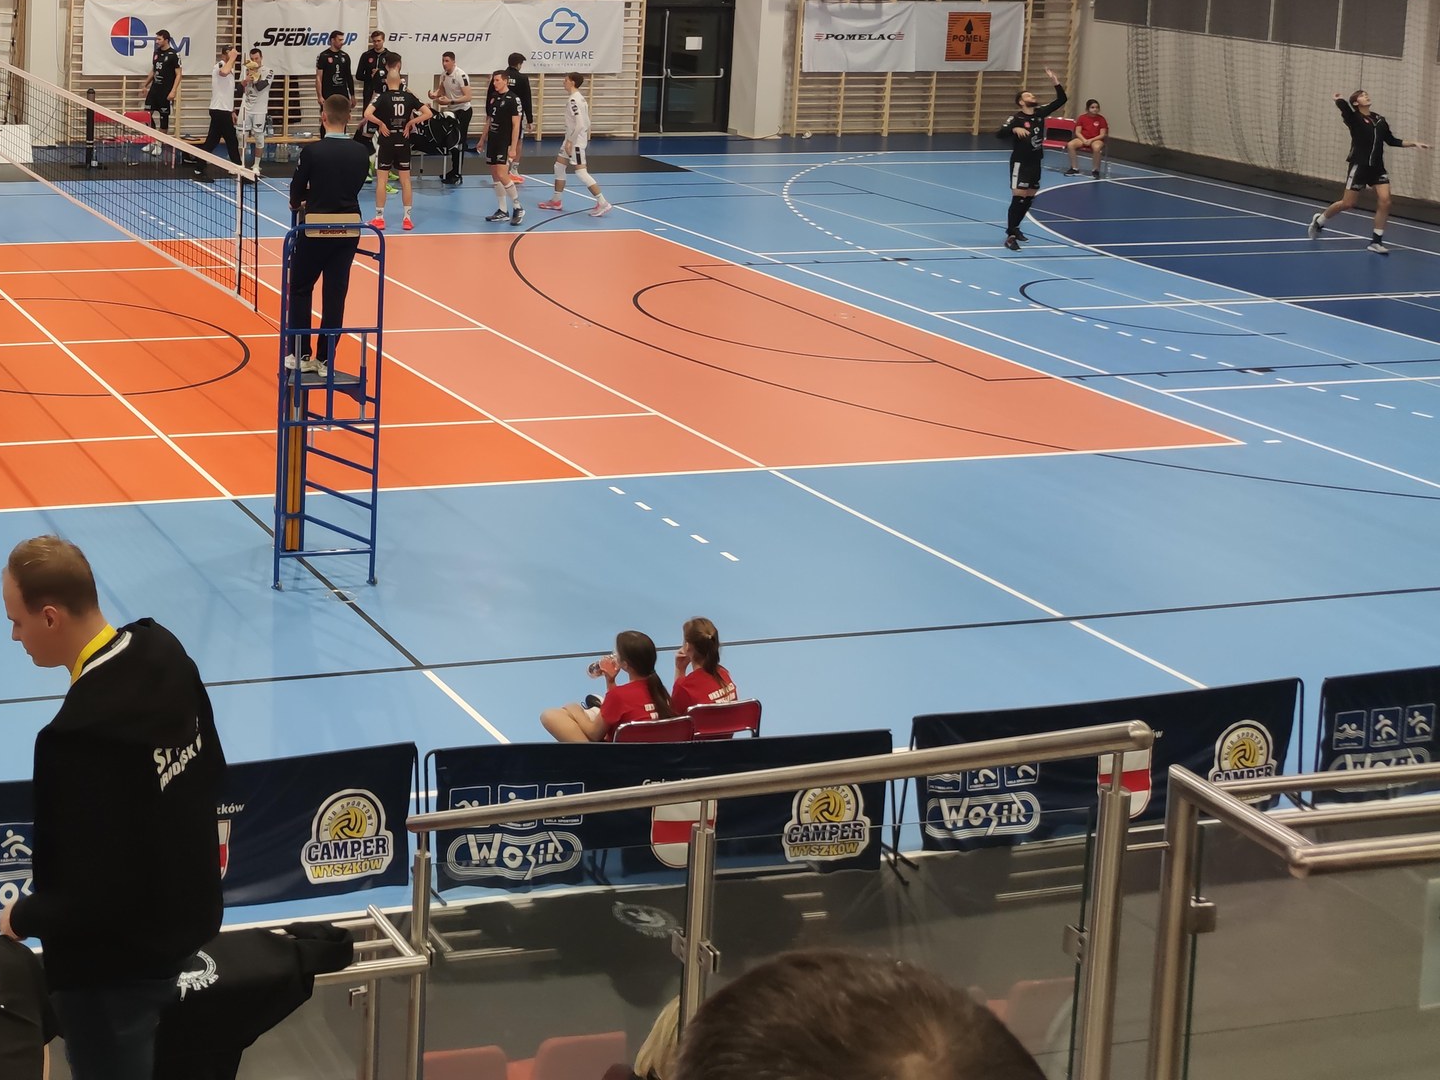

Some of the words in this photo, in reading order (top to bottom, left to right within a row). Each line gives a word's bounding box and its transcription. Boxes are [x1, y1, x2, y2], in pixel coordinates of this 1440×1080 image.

[388, 32, 492, 42] BF-TRANSPORT
[825, 33, 897, 41] POMELAC
[952, 34, 984, 42] POMEL
[531, 51, 594, 60] ZSOFTWARE
[393, 103, 405, 116] 10
[492, 106, 497, 116] 2
[323, 810, 337, 832] KLUB
[340, 800, 374, 827] SPORTOWY
[788, 822, 864, 843] CAMPER
[307, 837, 388, 862] CAMPER
[310, 858, 384, 879] WYSZKÓW
